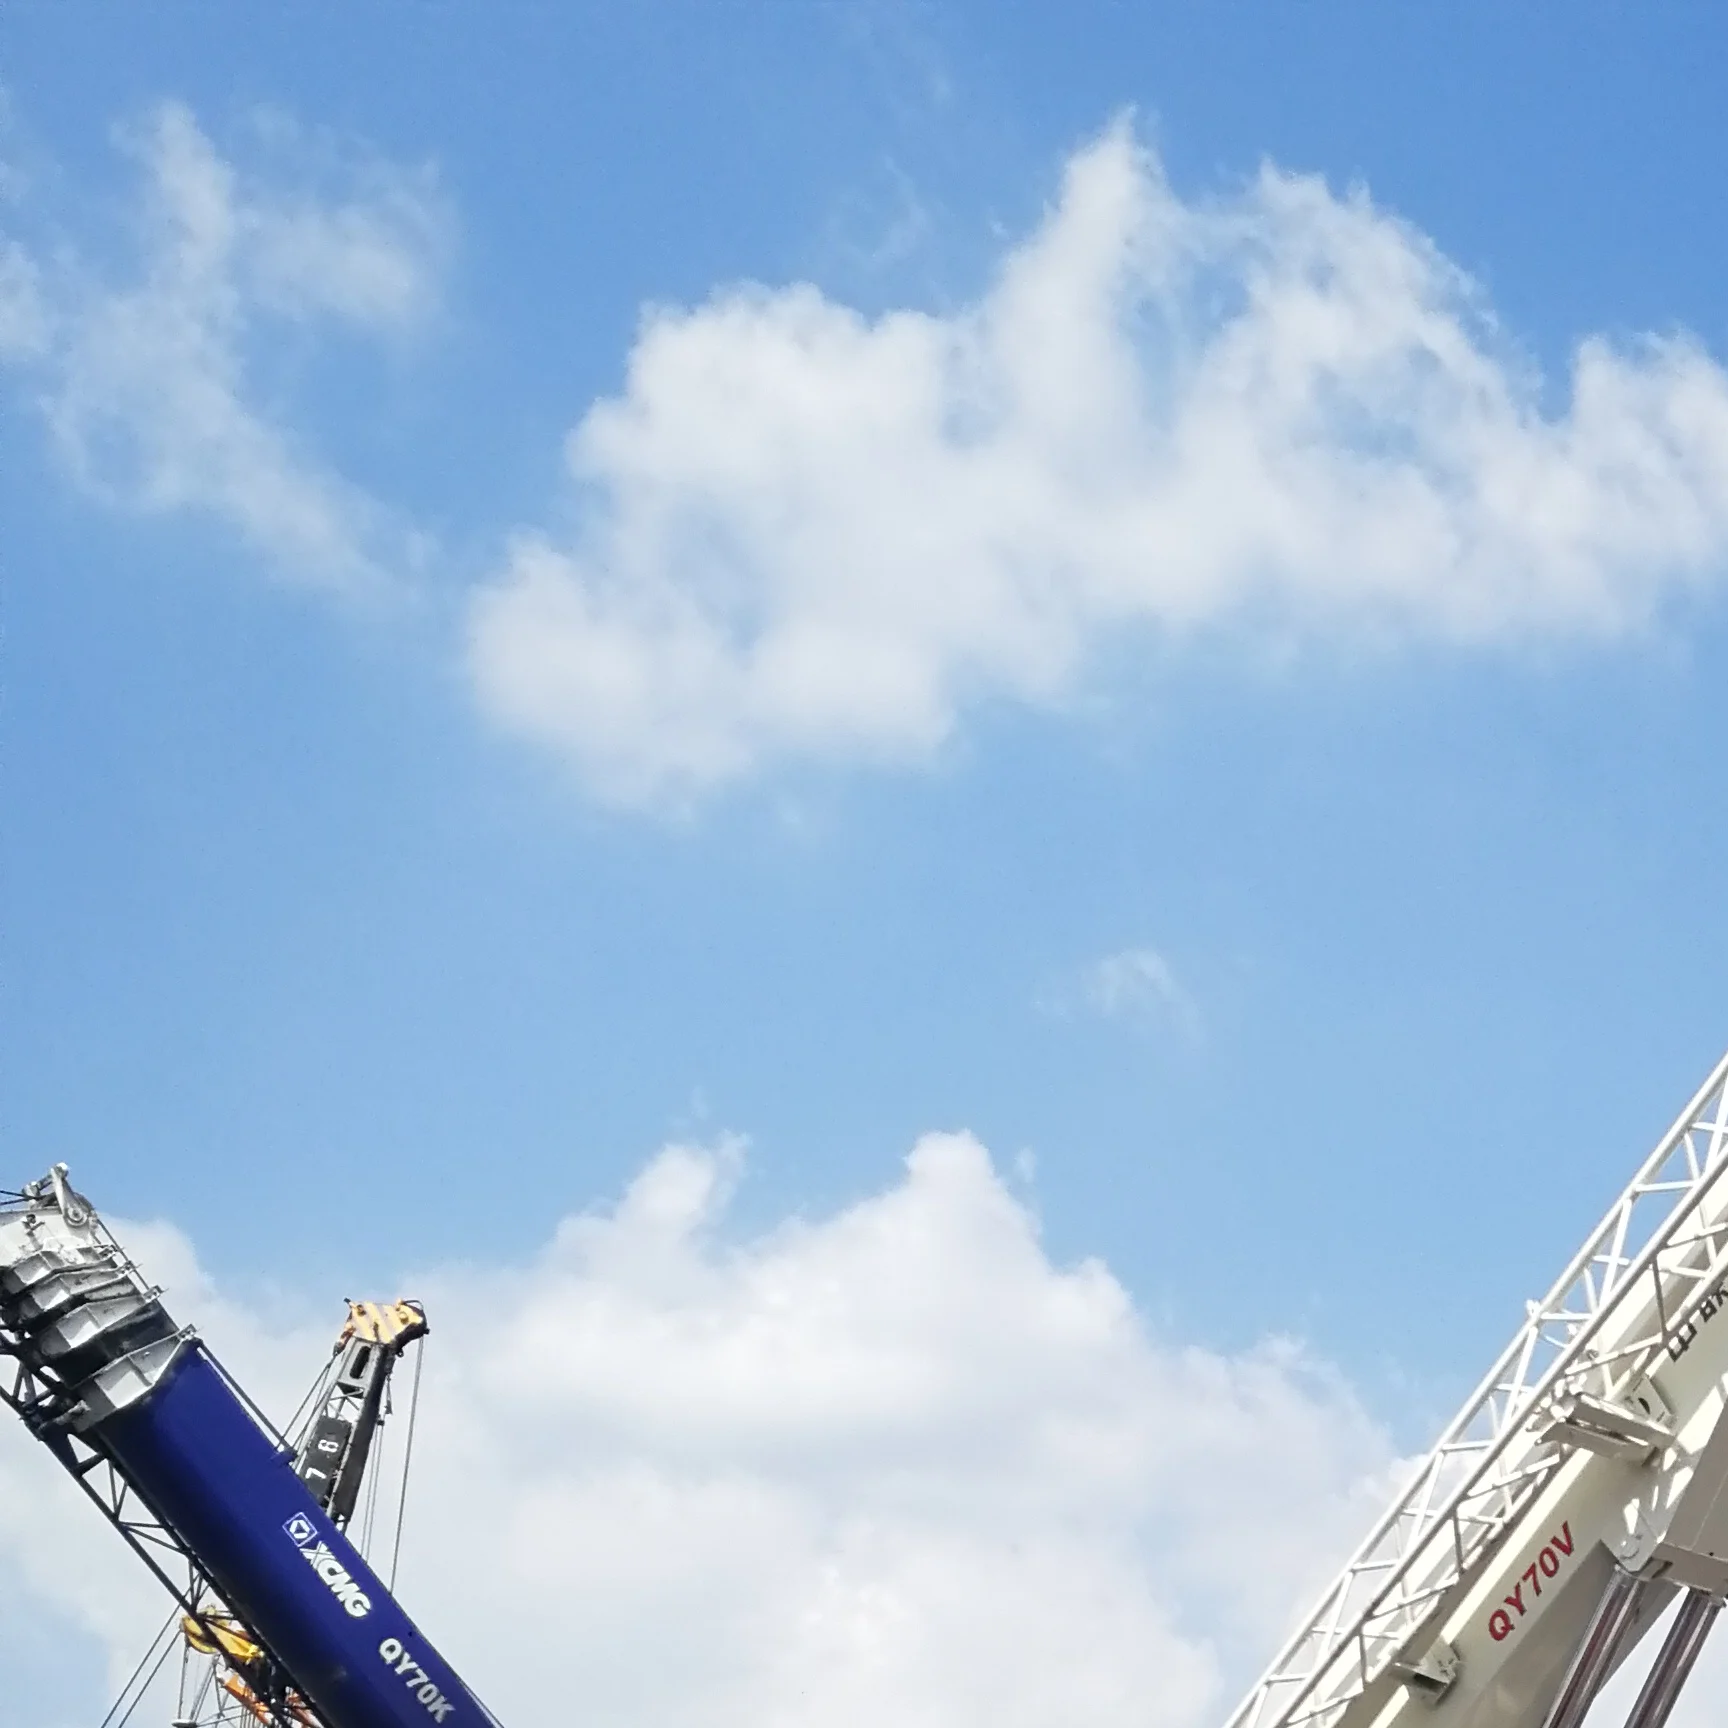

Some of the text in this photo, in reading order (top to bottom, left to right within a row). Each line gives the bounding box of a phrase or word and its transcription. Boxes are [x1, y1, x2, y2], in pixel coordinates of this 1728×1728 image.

[300, 1540, 372, 1618] XCMG
[1488, 1520, 1574, 1641] QY70V
[378, 1637, 456, 1724] QY70K
